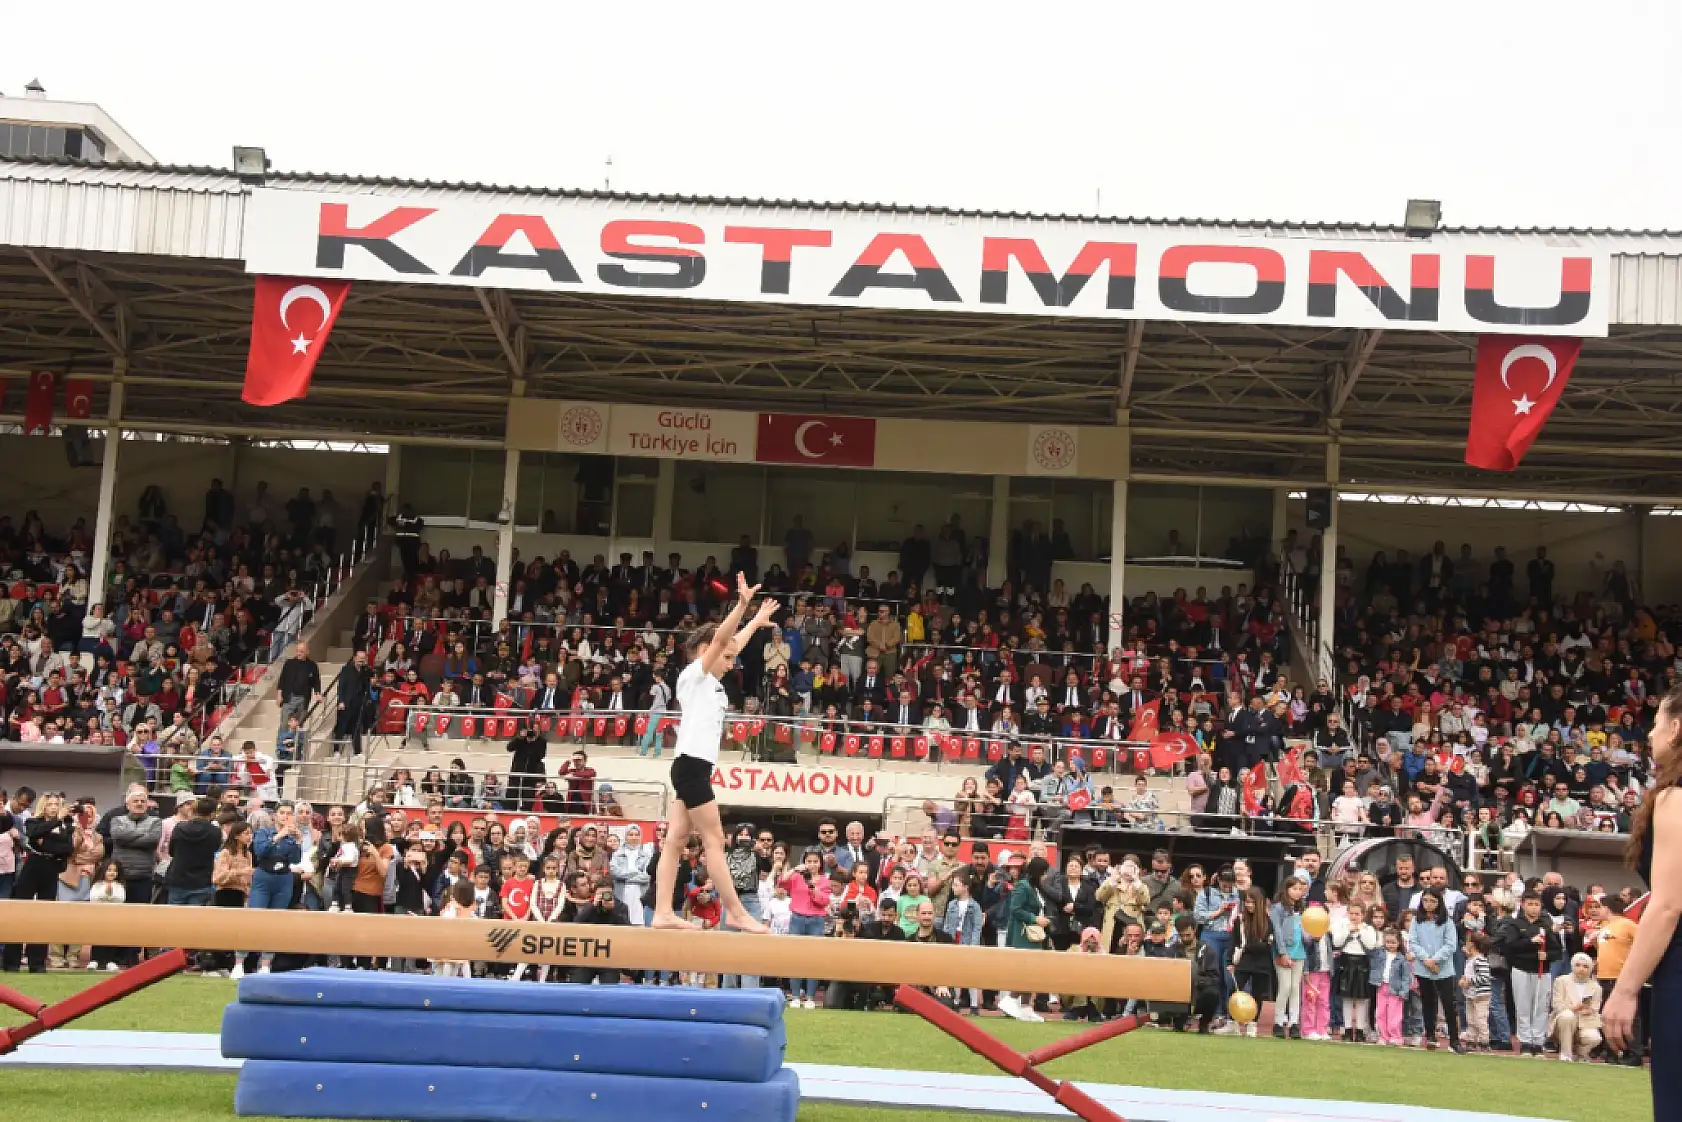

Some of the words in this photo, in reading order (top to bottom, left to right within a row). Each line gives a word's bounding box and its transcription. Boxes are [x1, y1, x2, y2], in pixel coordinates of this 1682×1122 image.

[315, 202, 1593, 326] KASTAMONU
[657, 411, 711, 431] Güçlü
[628, 432, 699, 455] Türkiye
[710, 767, 875, 797] ASTAMONU
[521, 934, 611, 958] SPIETH
